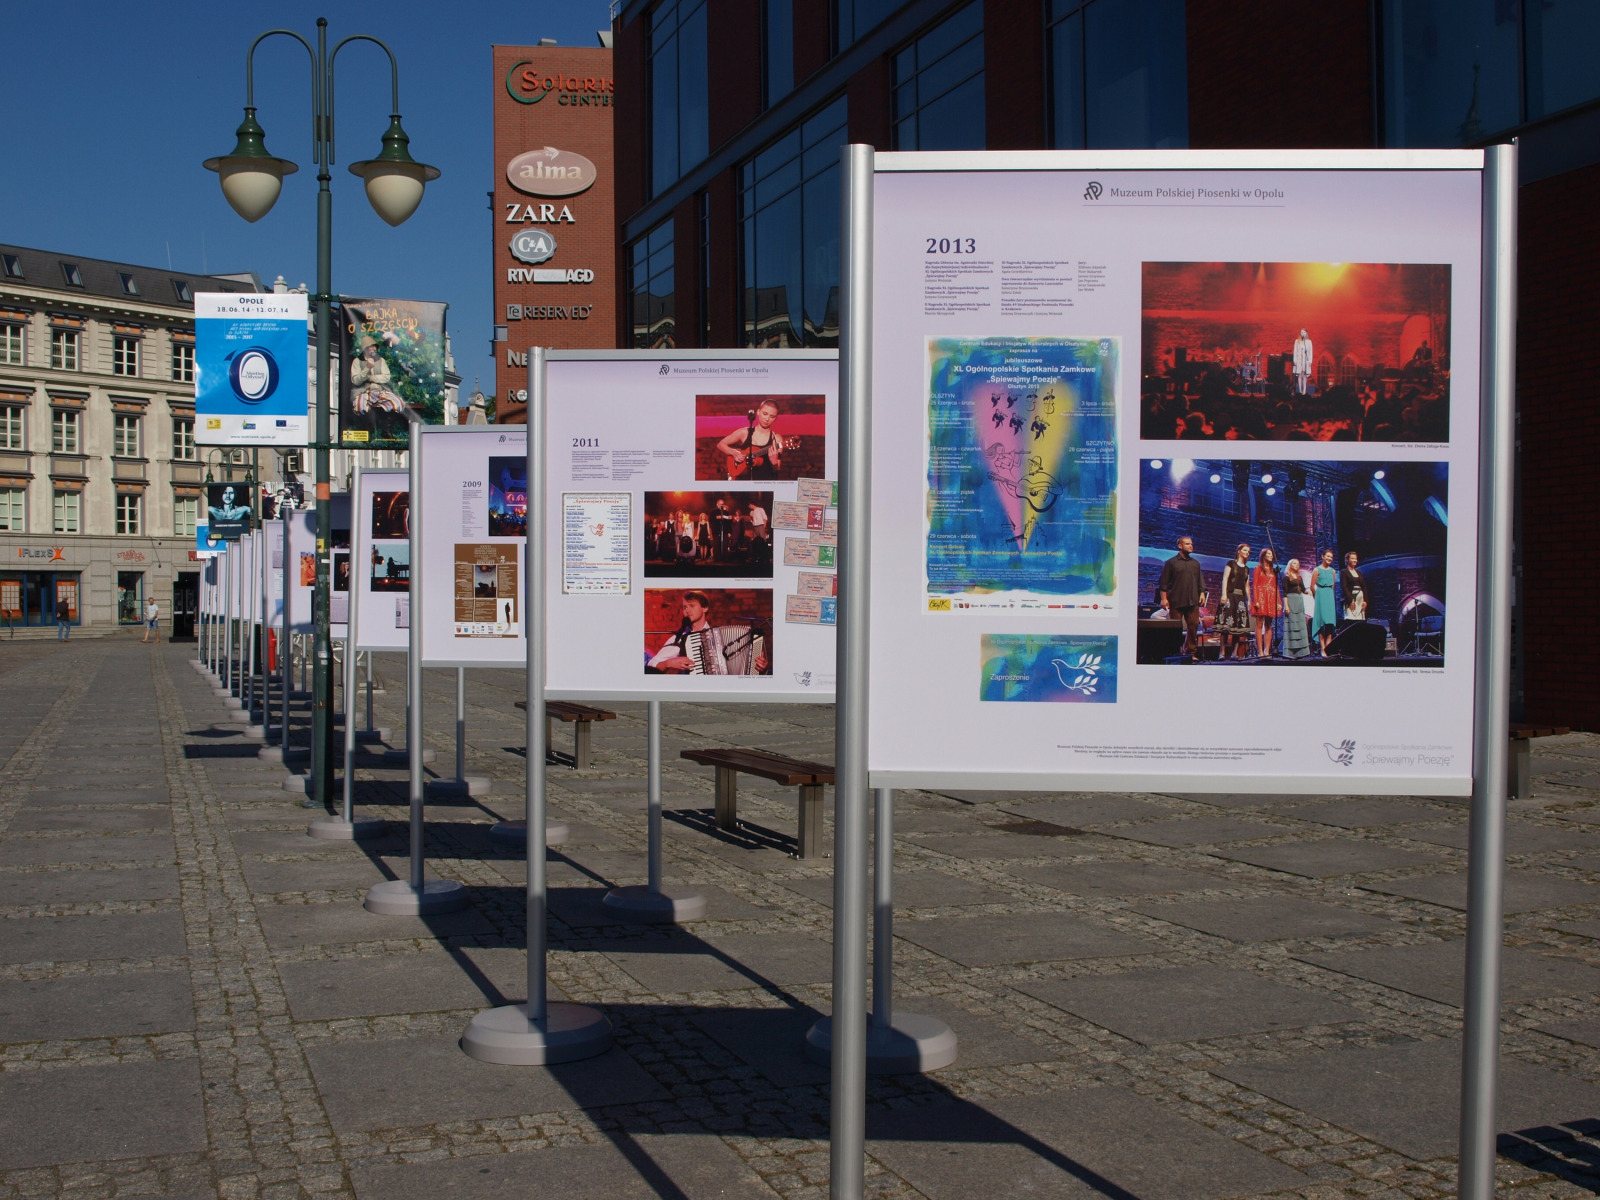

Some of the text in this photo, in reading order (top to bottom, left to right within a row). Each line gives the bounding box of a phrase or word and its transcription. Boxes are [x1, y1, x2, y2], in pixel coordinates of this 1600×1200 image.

[558, 94, 614, 106] CENTE
[519, 161, 583, 180] alma
[1110, 188, 1284, 200] Muzeum Polskiej Piosenki w Opolu
[506, 203, 576, 223] ZARA
[518, 236, 548, 254] C&A
[926, 237, 976, 254] 2013
[507, 268, 594, 283] RTV AGD
[365, 307, 398, 320] BAJKA
[524, 305, 590, 318] RESERVED
[347, 323, 356, 334] O
[965, 366, 1020, 375] Ogólnopolskie
[1021, 366, 1059, 375] Spotkania
[1060, 366, 1096, 374] Zamkowe
[572, 437, 599, 448] 2011
[462, 480, 482, 488] 2009
[990, 673, 1030, 682] Zaproszenie
